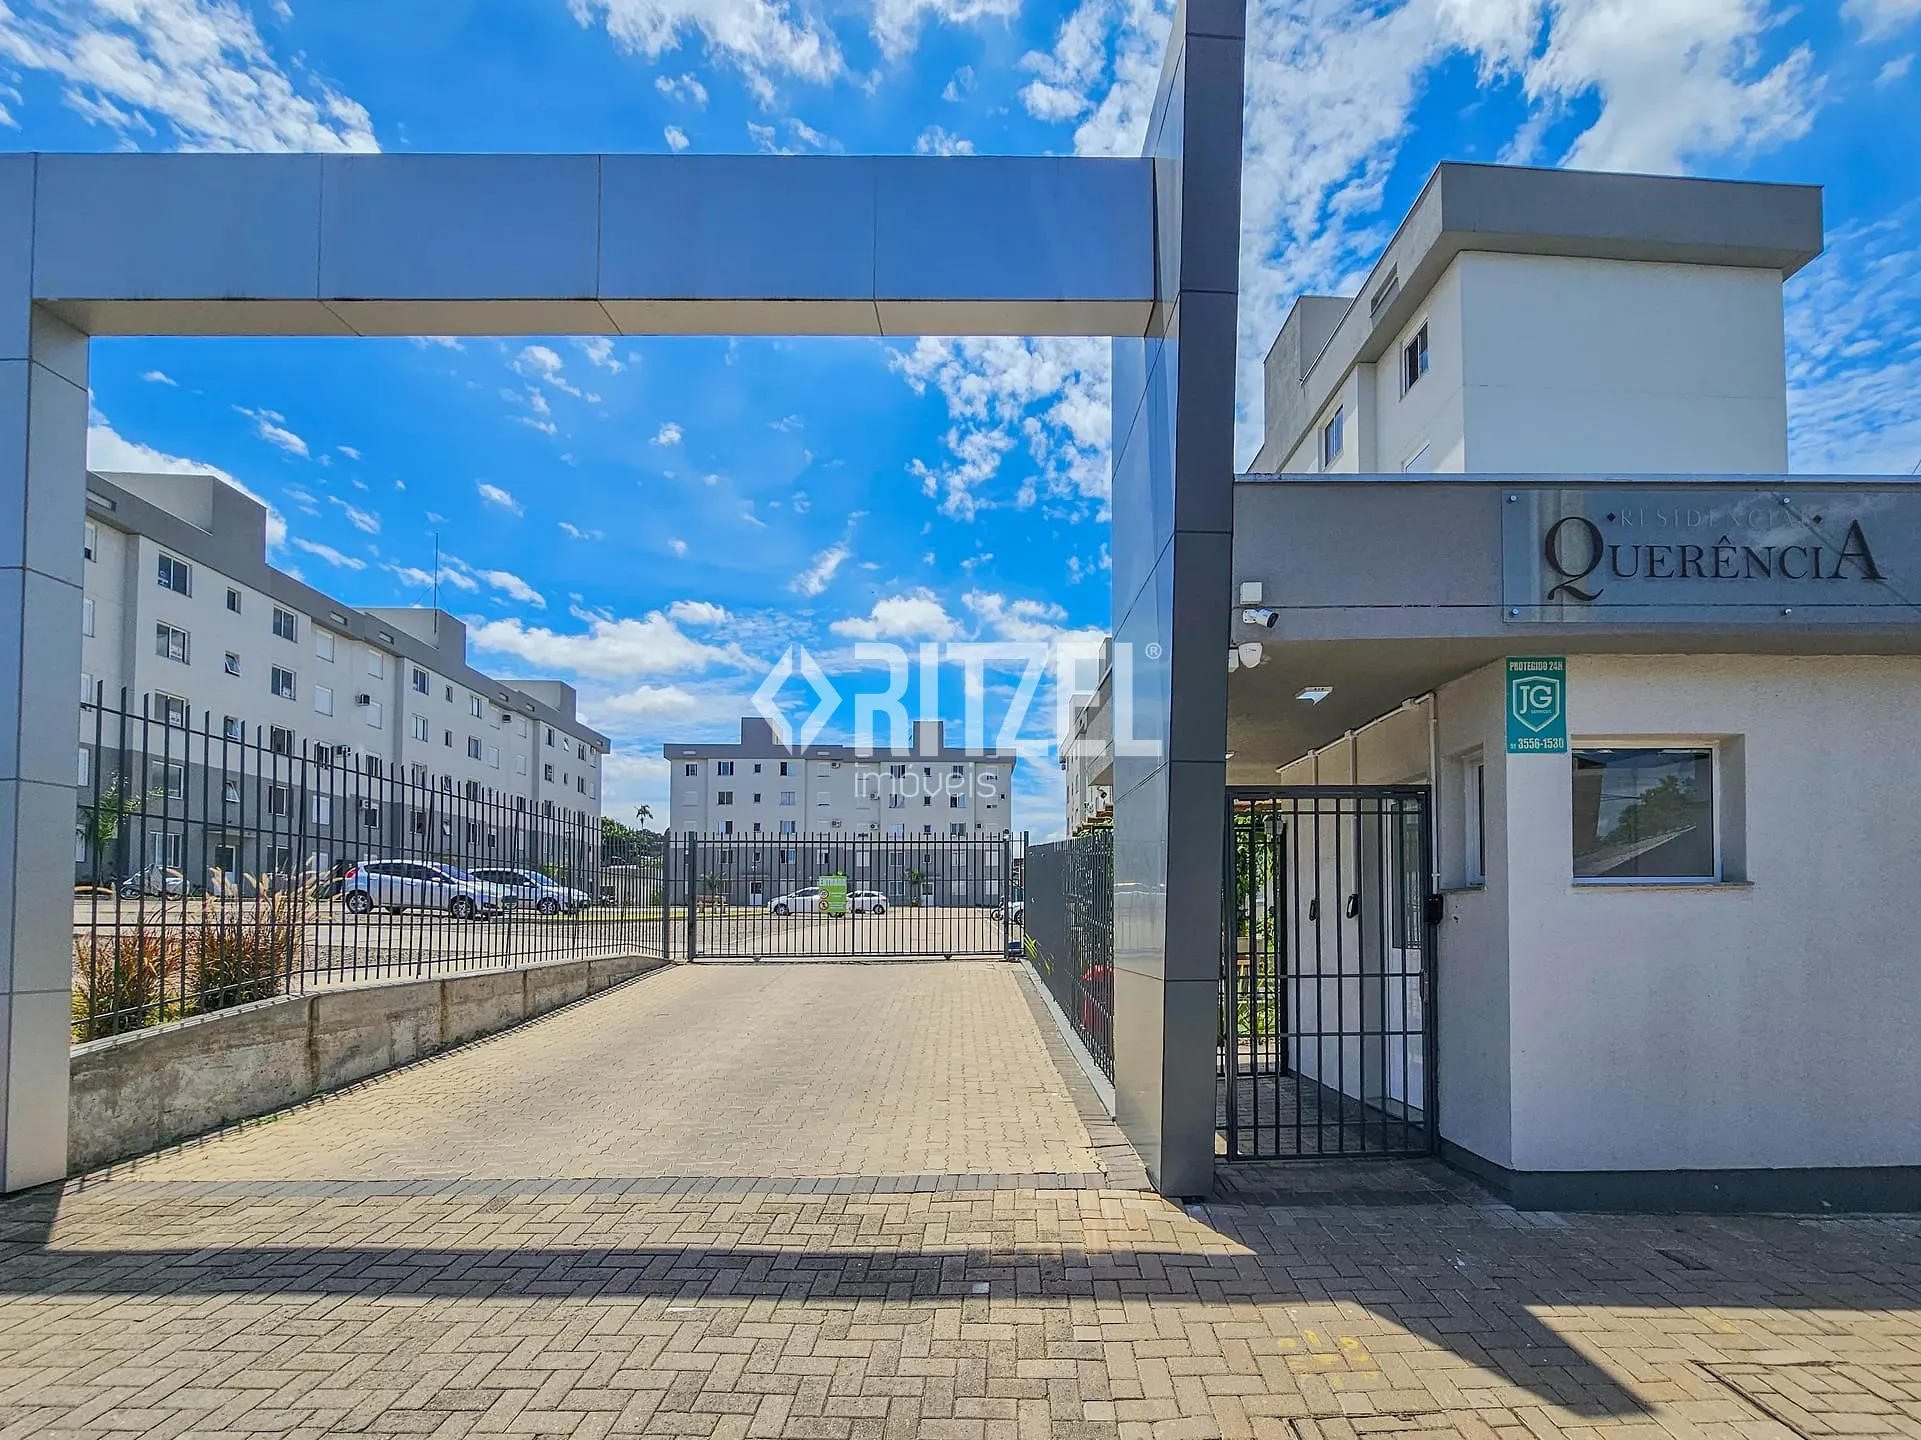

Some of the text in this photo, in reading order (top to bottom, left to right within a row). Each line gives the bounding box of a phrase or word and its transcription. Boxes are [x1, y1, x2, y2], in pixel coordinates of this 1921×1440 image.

[1544, 516, 1888, 602] QUERÊNCIA
[1509, 661, 1548, 671] PROTEGIDO
[1520, 685, 1552, 714] JG
[1517, 737, 1564, 749] 3556-1530
